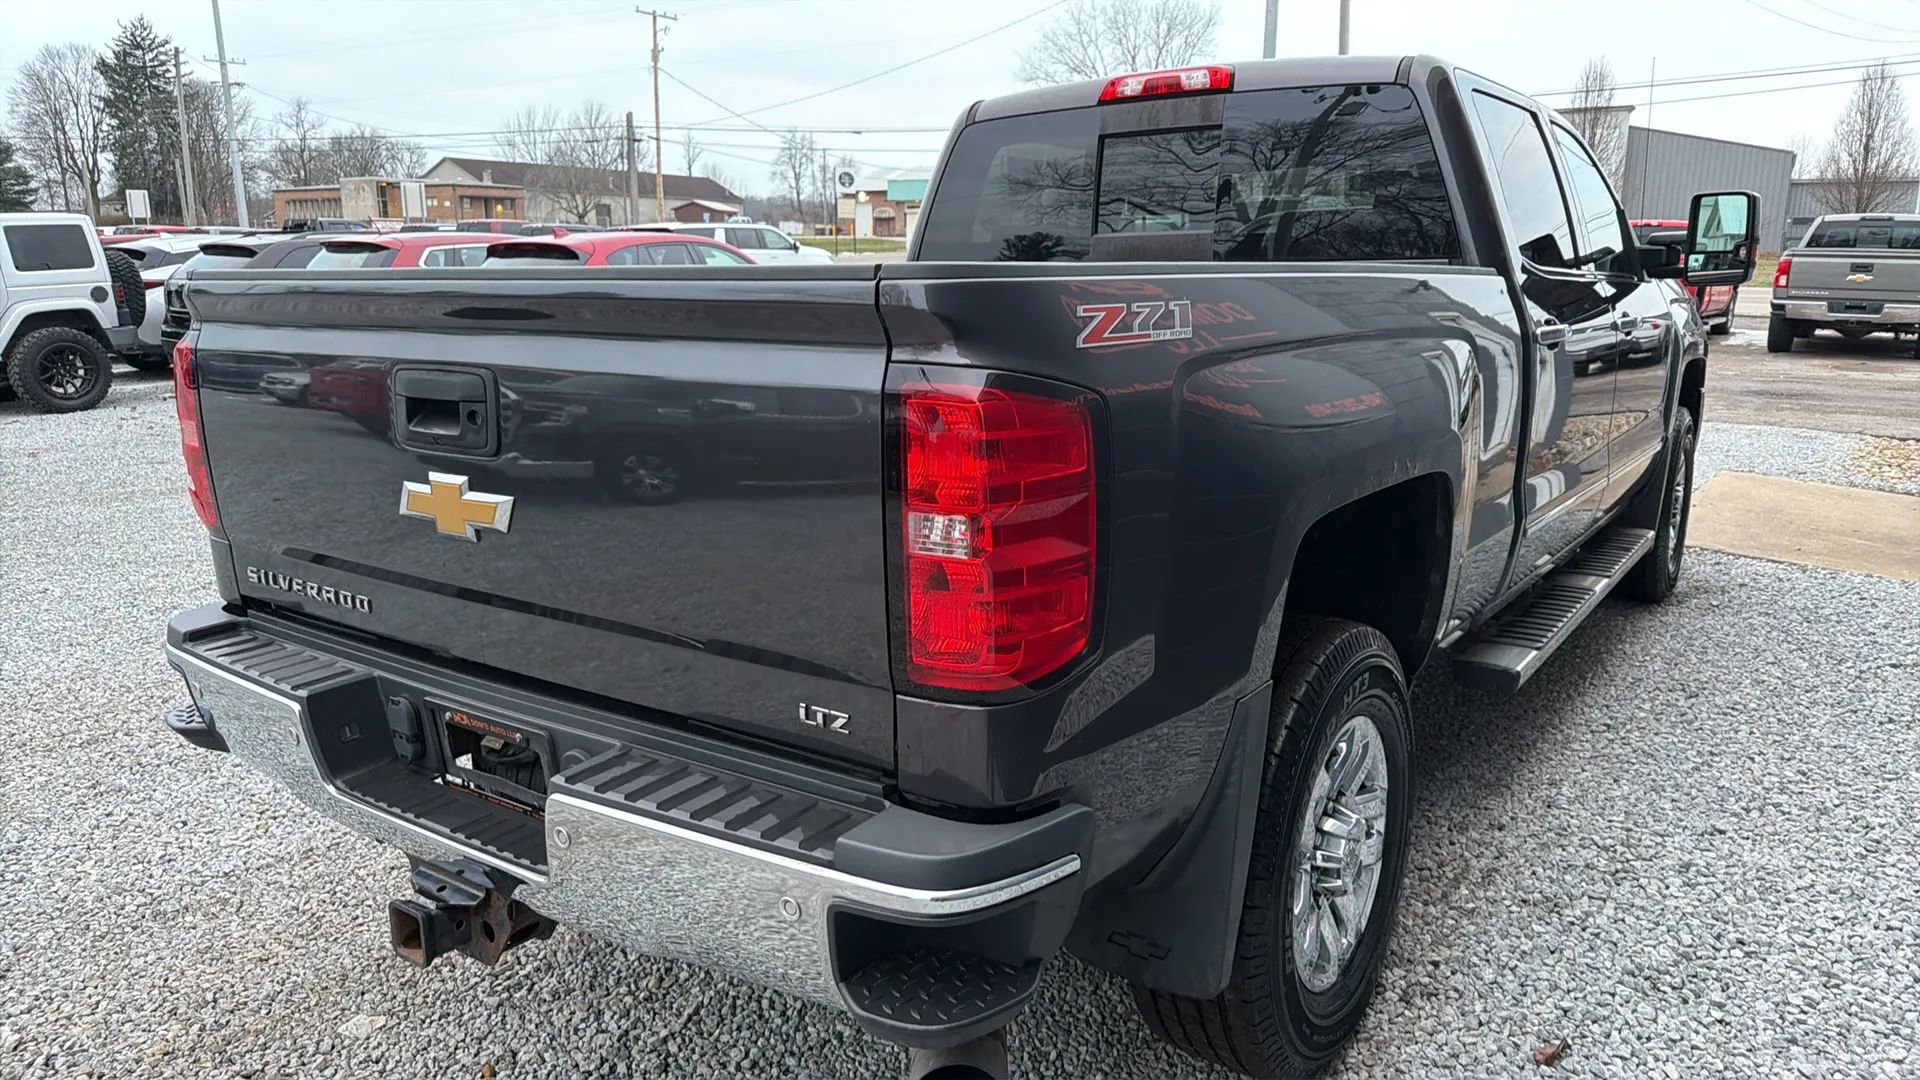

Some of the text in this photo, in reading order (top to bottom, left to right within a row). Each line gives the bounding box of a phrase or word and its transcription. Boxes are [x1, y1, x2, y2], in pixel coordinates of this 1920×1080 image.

[1076, 300, 1191, 348] Z71
[1152, 329, 1192, 339] OFF ROAD
[247, 566, 371, 613] SILVERADO
[799, 702, 849, 733] LTZ
